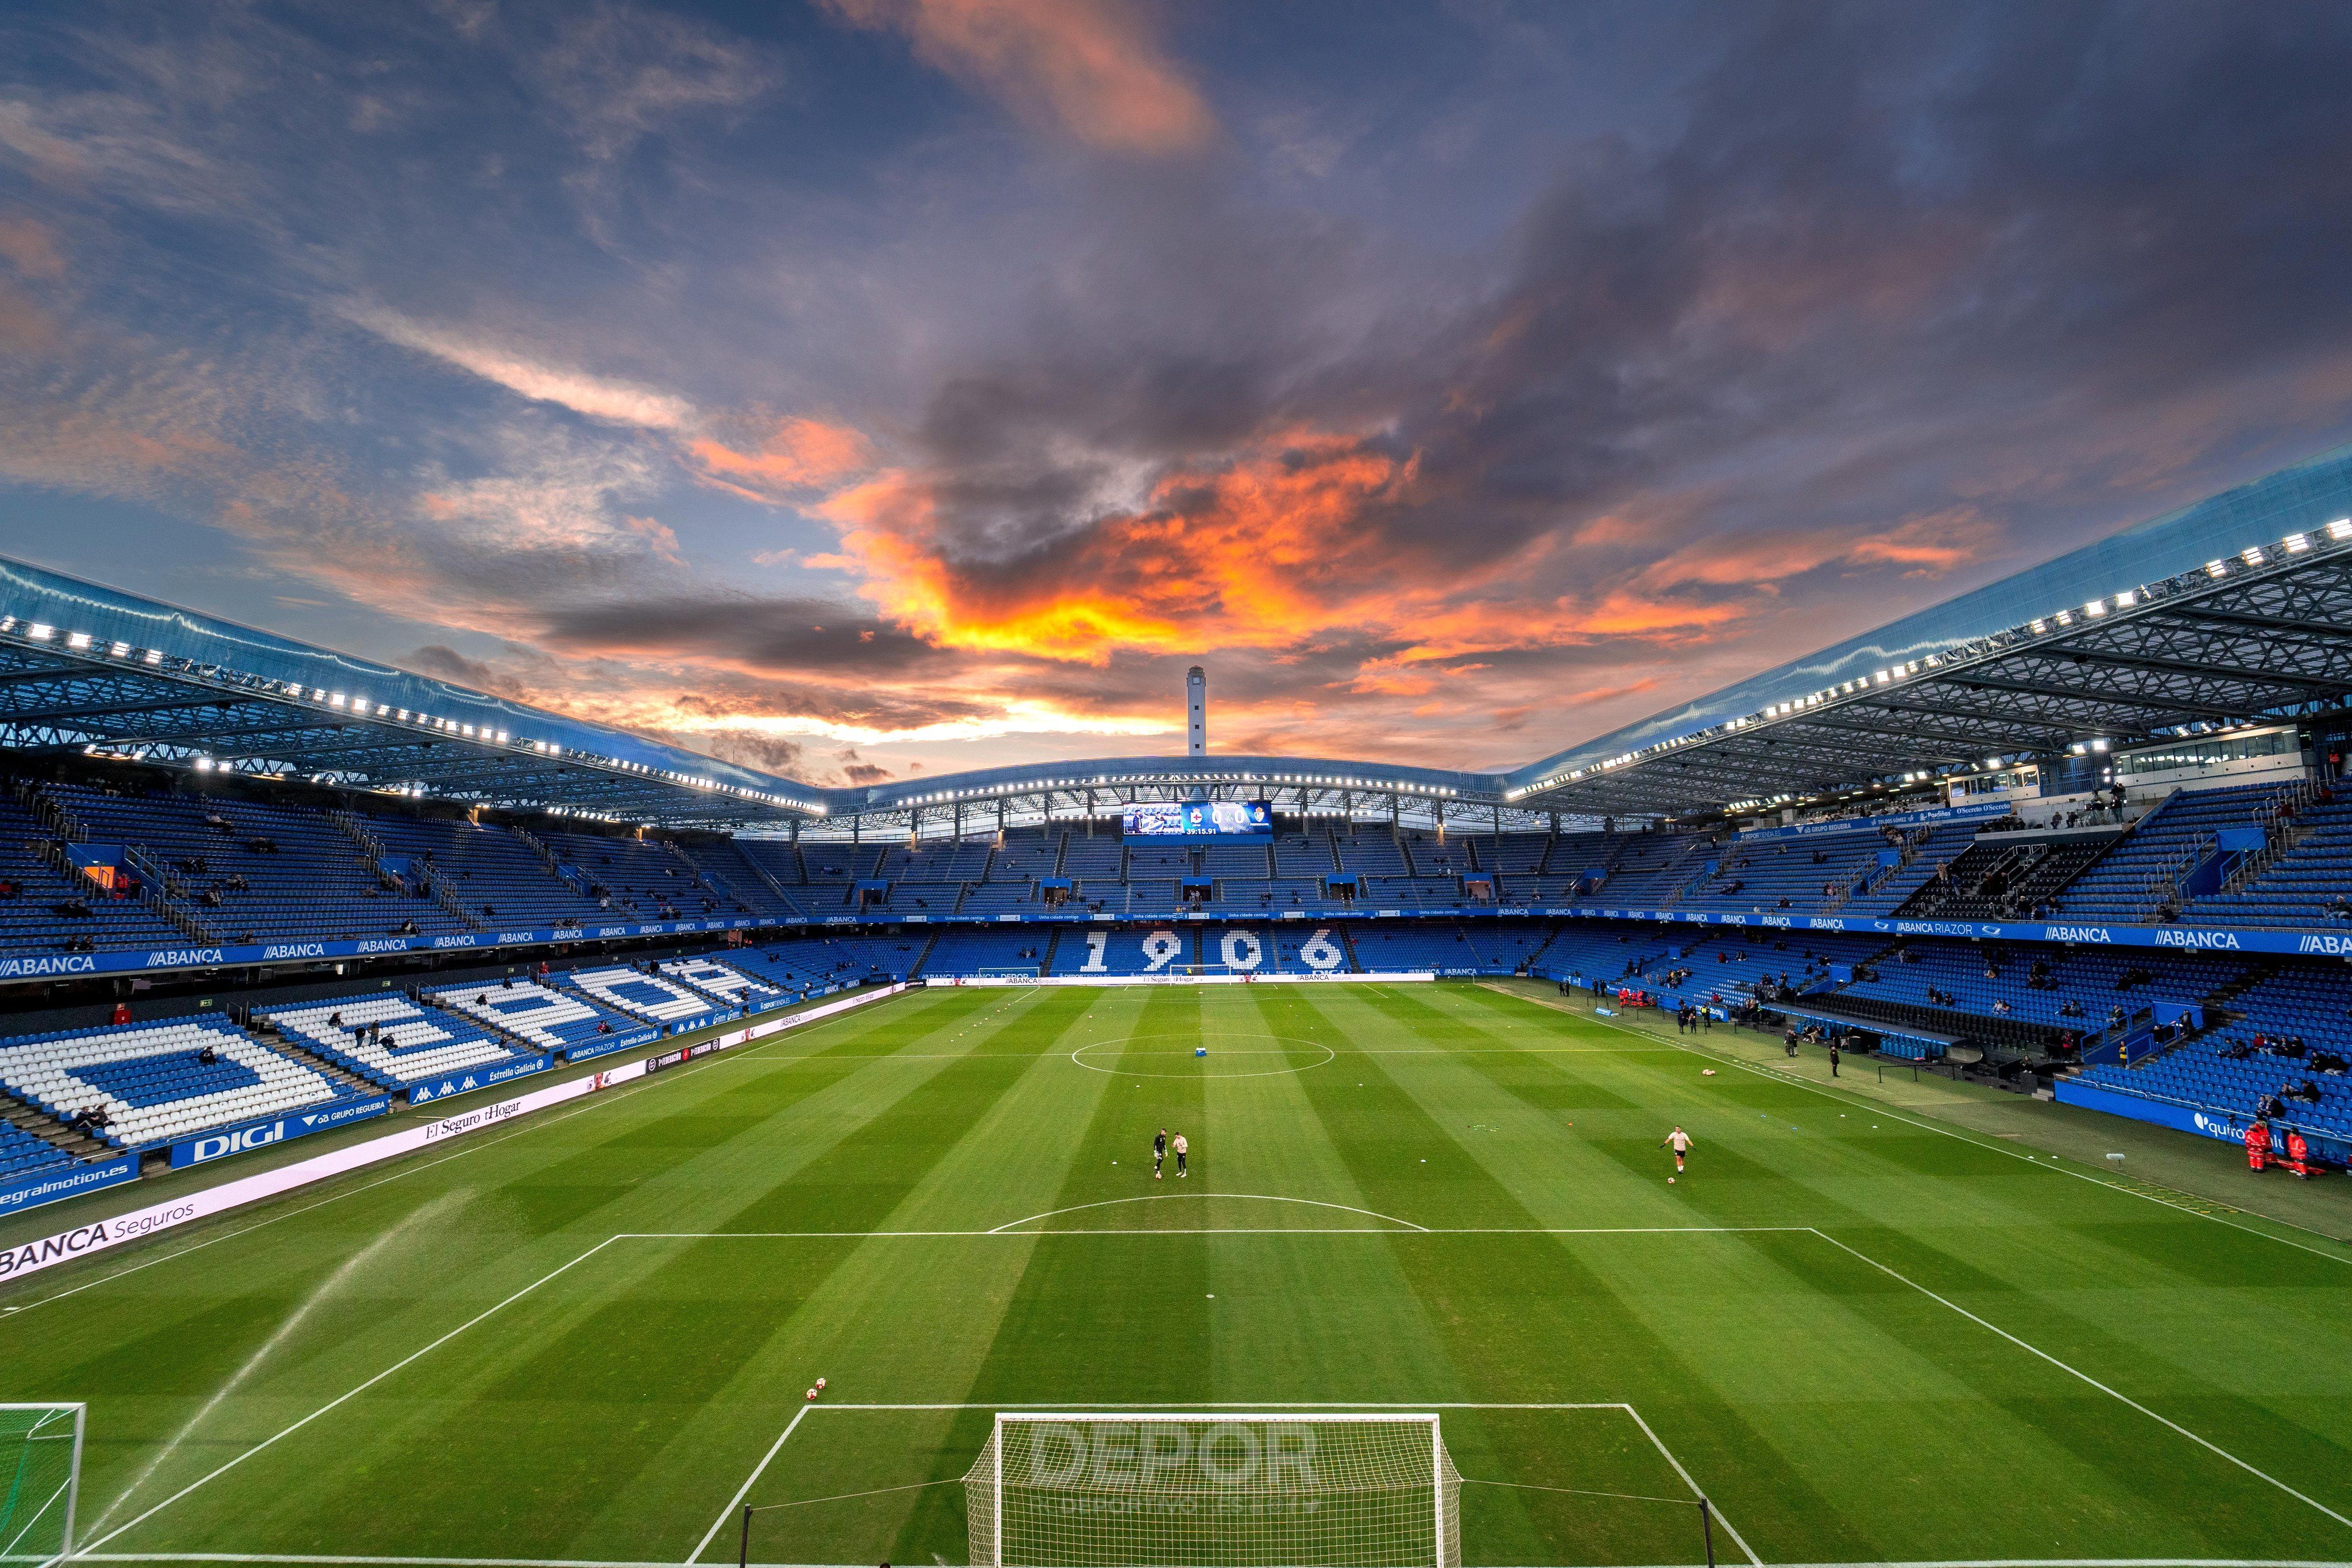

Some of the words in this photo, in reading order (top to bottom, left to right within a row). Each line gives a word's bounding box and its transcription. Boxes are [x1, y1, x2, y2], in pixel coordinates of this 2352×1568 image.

[1935, 924, 1972, 935] RIAZOR
[595, 1042, 615, 1053] RIAZOR
[620, 1036, 637, 1047] Estrella
[637, 1033, 652, 1043] Galicia
[489, 1067, 513, 1082] Estrella
[514, 1062, 535, 1075] Galicia
[331, 1108, 354, 1120] GRUPO
[355, 1101, 385, 1114] REGUEIRA
[426, 1125, 438, 1139] El
[441, 1114, 480, 1135] Seguro
[194, 1121, 284, 1162] DIGI
[114, 1203, 194, 1238] Seguros
